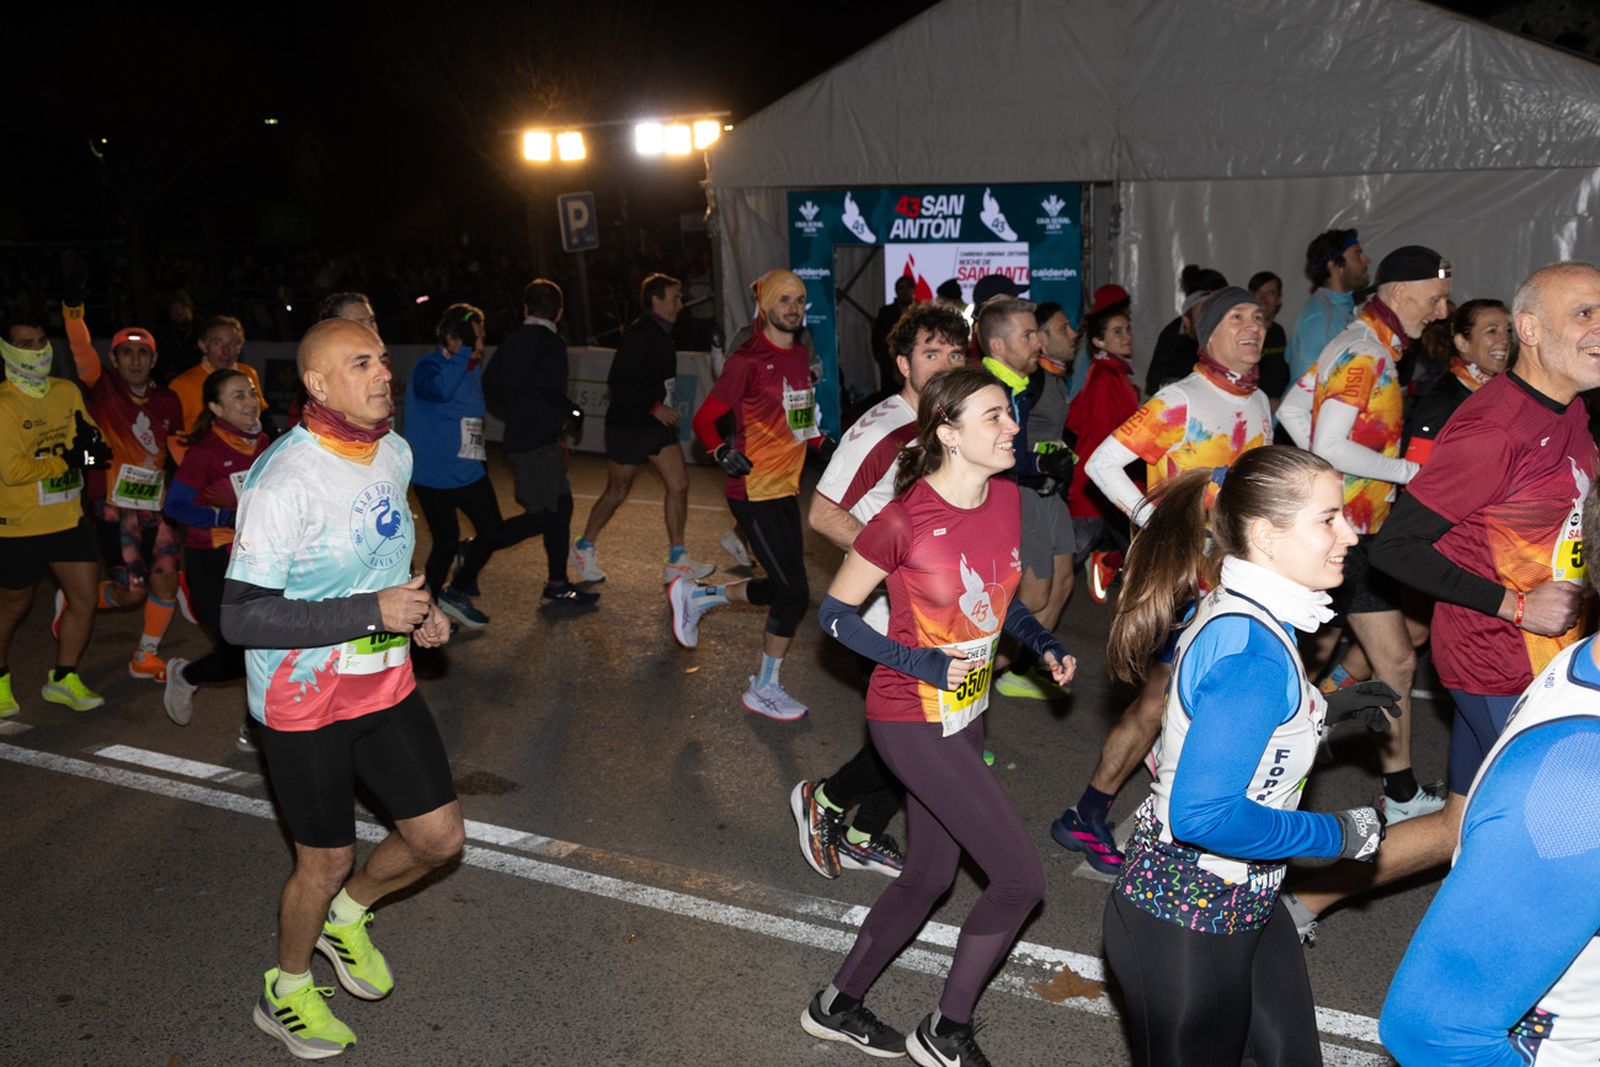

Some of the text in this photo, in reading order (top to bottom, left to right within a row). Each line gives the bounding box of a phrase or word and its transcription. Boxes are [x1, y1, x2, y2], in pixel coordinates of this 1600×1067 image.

[896, 194, 965, 219] 43 SAN
[567, 200, 589, 245] P
[851, 219, 865, 236] 43
[889, 213, 961, 239] ANTÓN
[991, 217, 1006, 234] 43
[957, 266, 990, 281] SAN
[1031, 267, 1078, 278] calderón
[971, 599, 989, 624] 43
[955, 667, 990, 701] 5501
